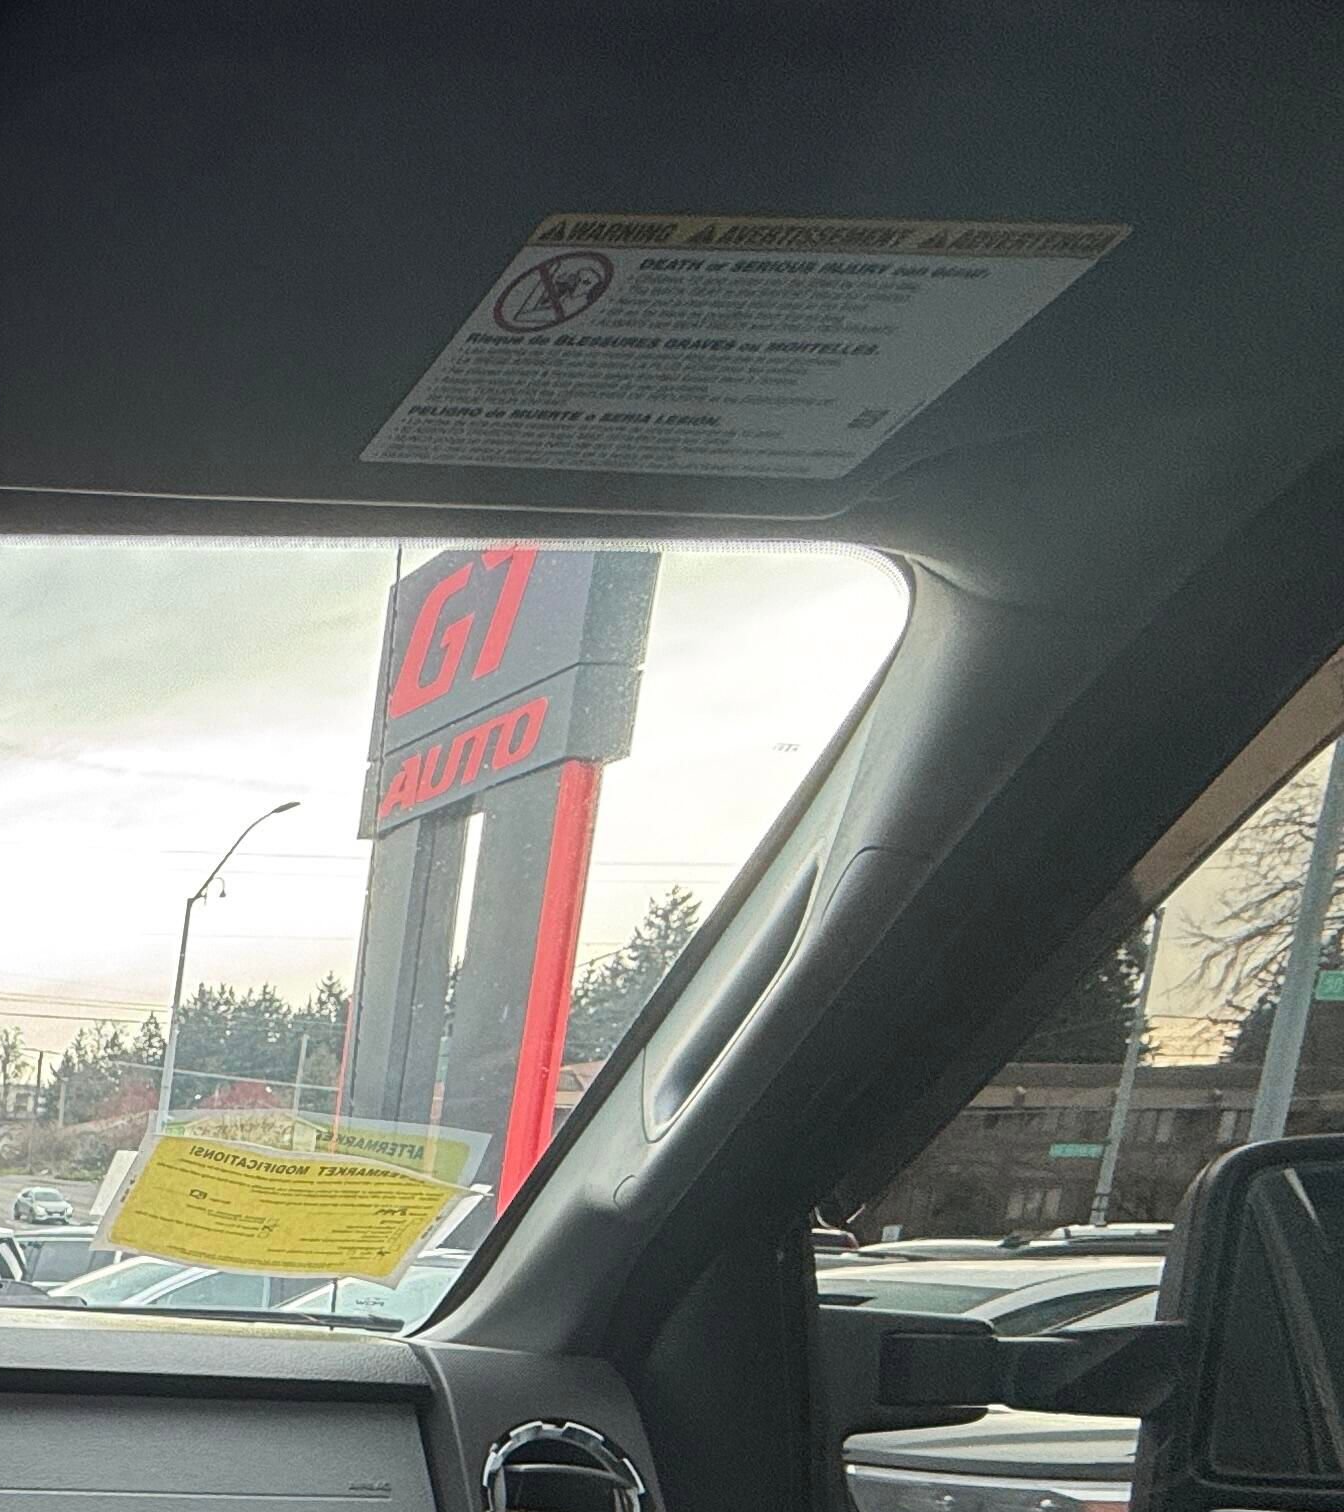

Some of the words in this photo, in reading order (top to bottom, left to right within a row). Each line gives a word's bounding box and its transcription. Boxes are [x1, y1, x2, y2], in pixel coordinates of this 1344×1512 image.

[567, 221, 679, 242] WARNING
[639, 259, 705, 271] DEATH
[731, 261, 816, 273] SERIOUS
[553, 334, 661, 349] BLESSURES
[664, 338, 735, 352] GRAVES
[407, 406, 482, 419] PELIGRO
[510, 408, 582, 421] MUERTE
[378, 696, 549, 818] AUTO
